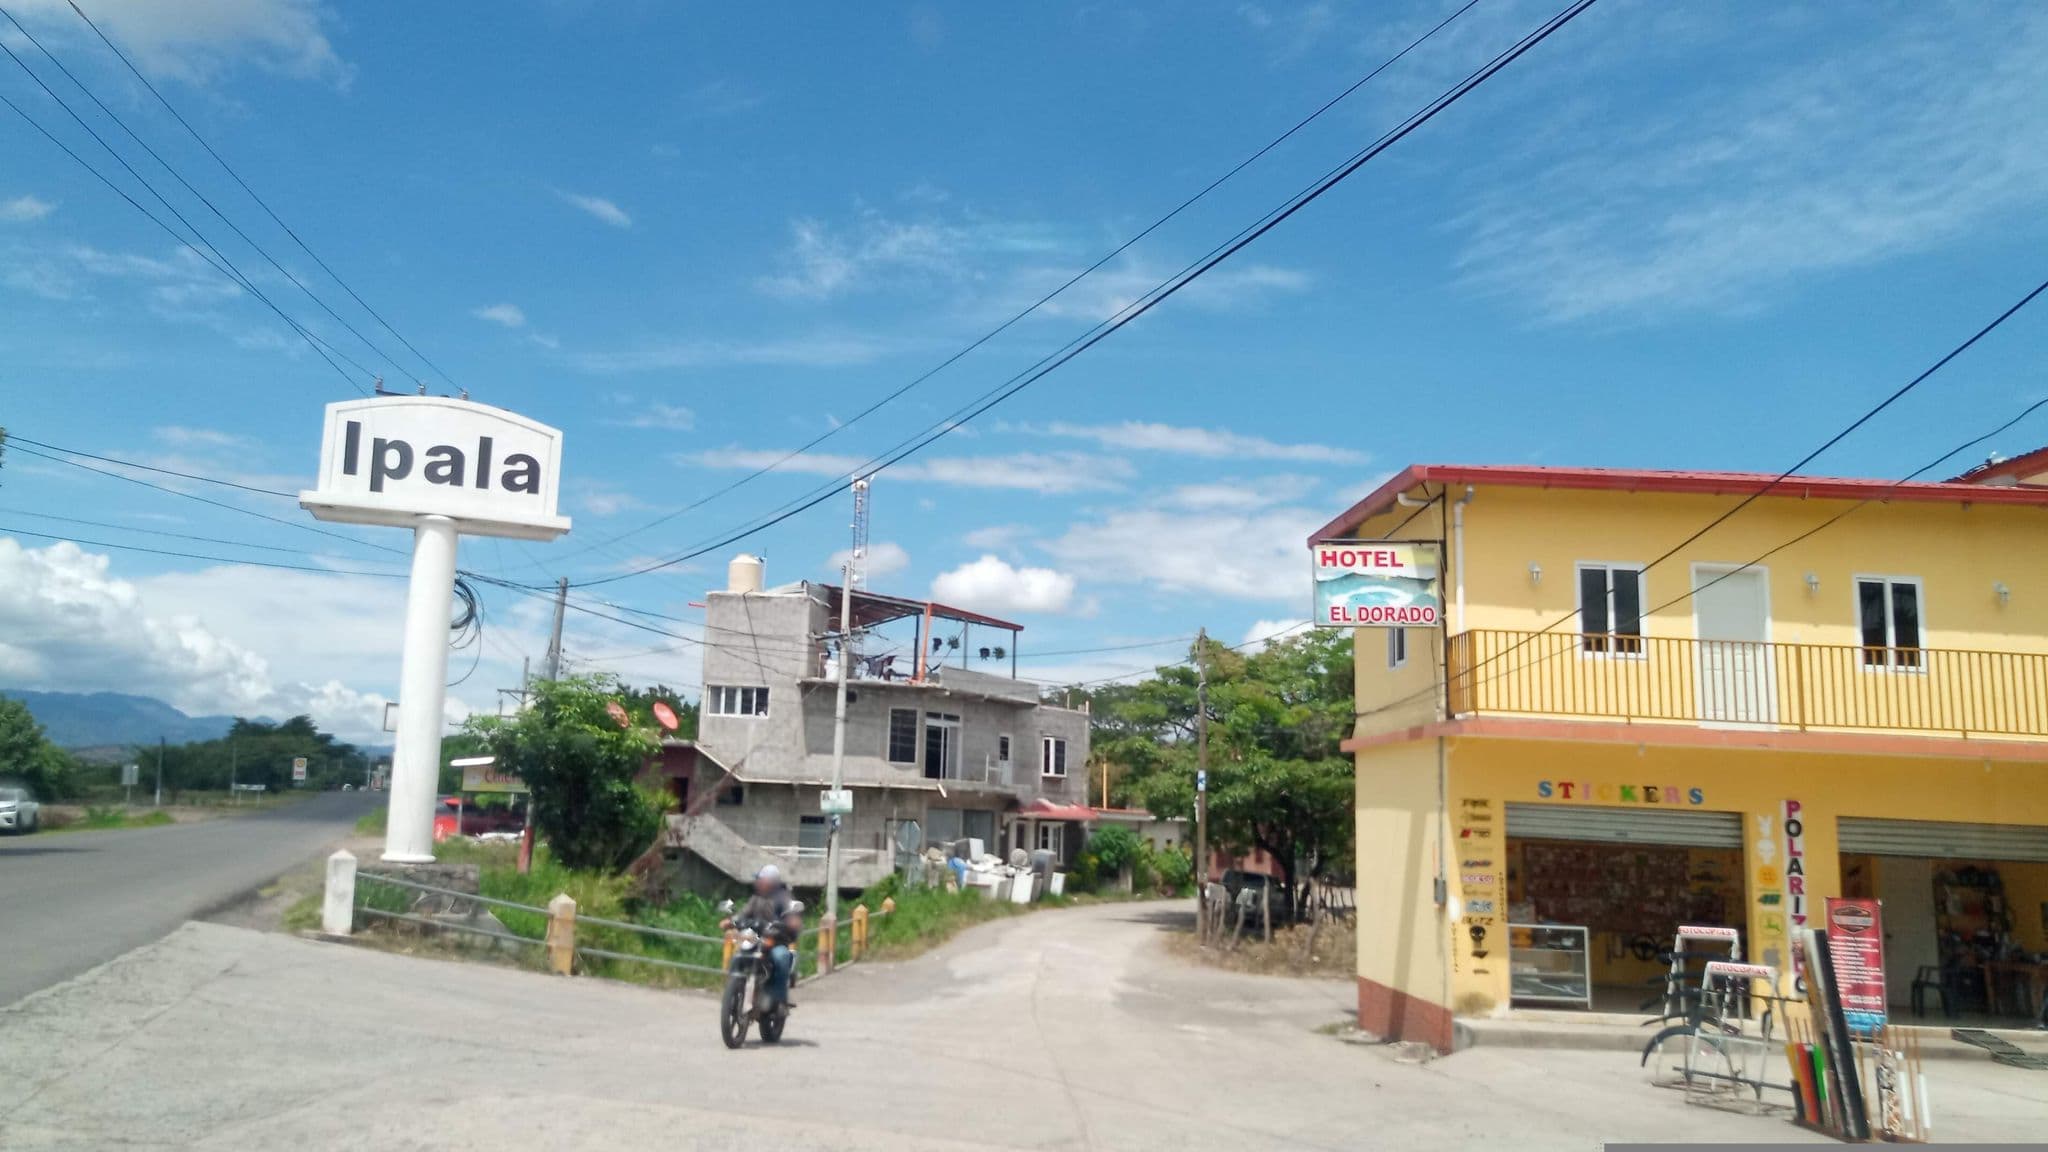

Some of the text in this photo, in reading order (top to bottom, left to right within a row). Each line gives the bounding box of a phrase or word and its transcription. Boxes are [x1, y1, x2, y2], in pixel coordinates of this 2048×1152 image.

[343, 420, 541, 494] Ipala
[1320, 550, 1404, 567] HOTEL
[1330, 606, 1436, 623] EL DORADO
[1538, 780, 1704, 805] STICKERS
